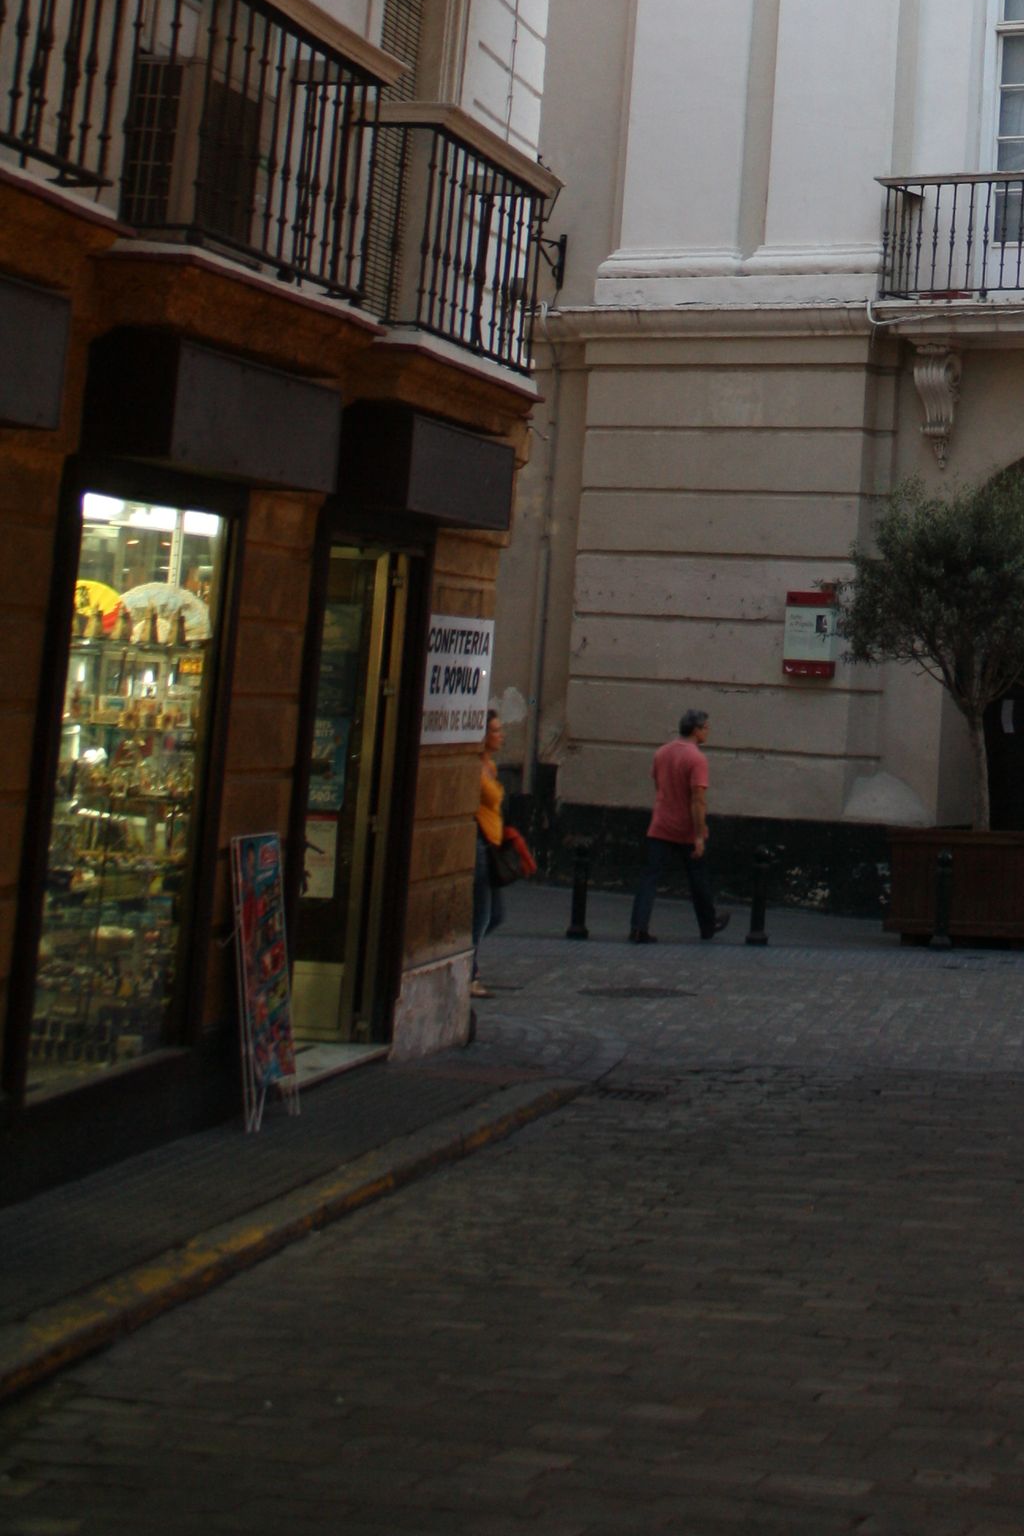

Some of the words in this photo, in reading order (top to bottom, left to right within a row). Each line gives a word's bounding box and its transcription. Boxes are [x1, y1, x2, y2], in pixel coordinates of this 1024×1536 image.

[427, 627, 490, 656] CONFITERIA
[429, 665, 442, 695] EL
[450, 710, 460, 731] DE
